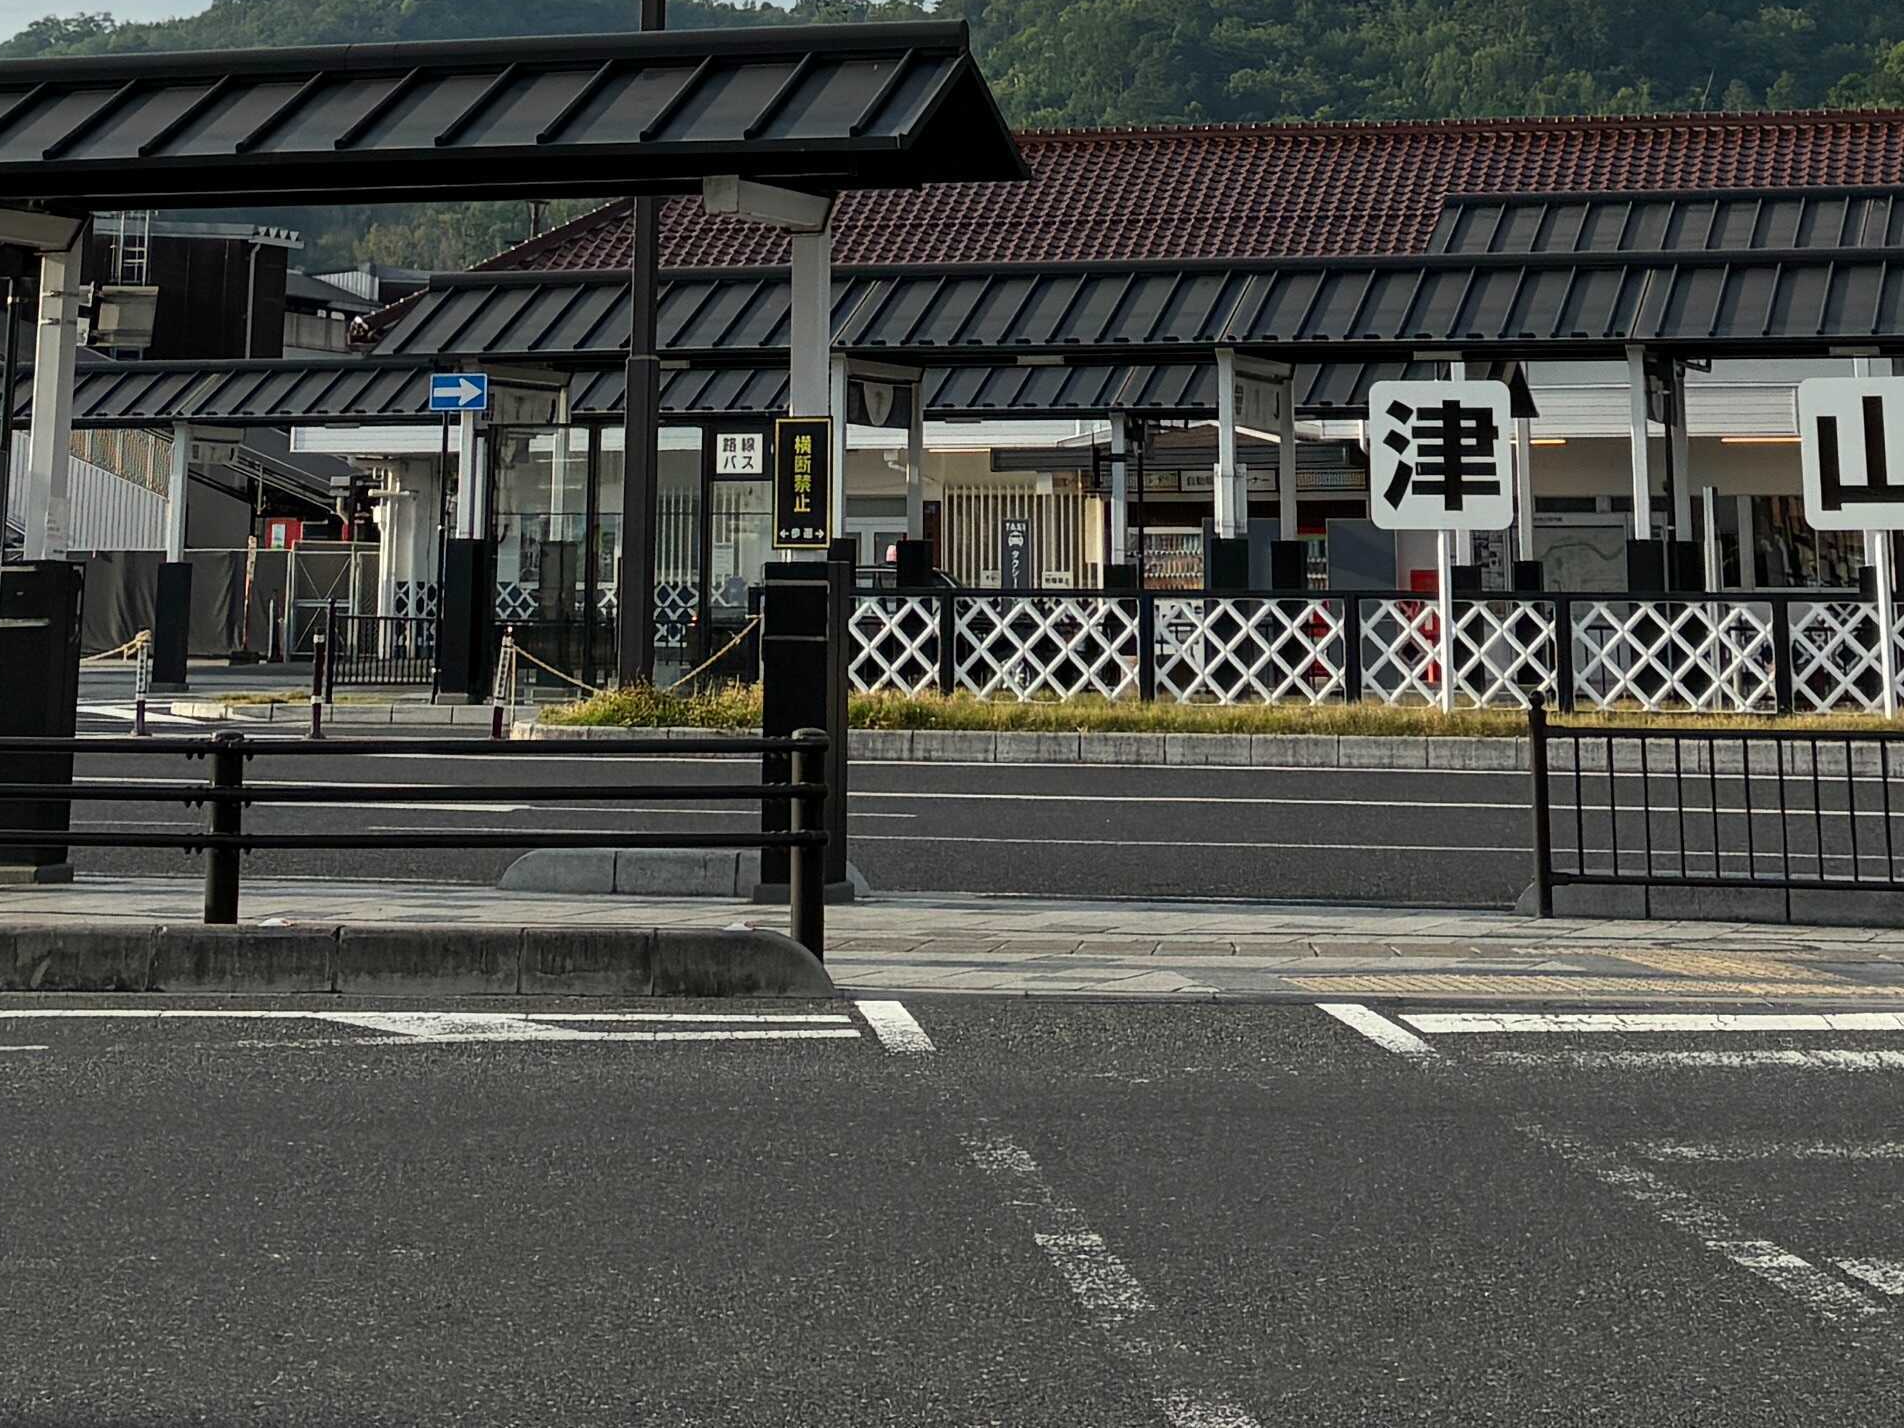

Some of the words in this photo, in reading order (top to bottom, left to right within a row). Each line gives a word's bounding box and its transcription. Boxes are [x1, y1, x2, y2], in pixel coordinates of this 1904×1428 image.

[723, 437, 755, 453] 路線
[724, 456, 754, 470] バス
[1383, 399, 1500, 511] 津
[794, 435, 812, 513] 横断禁止
